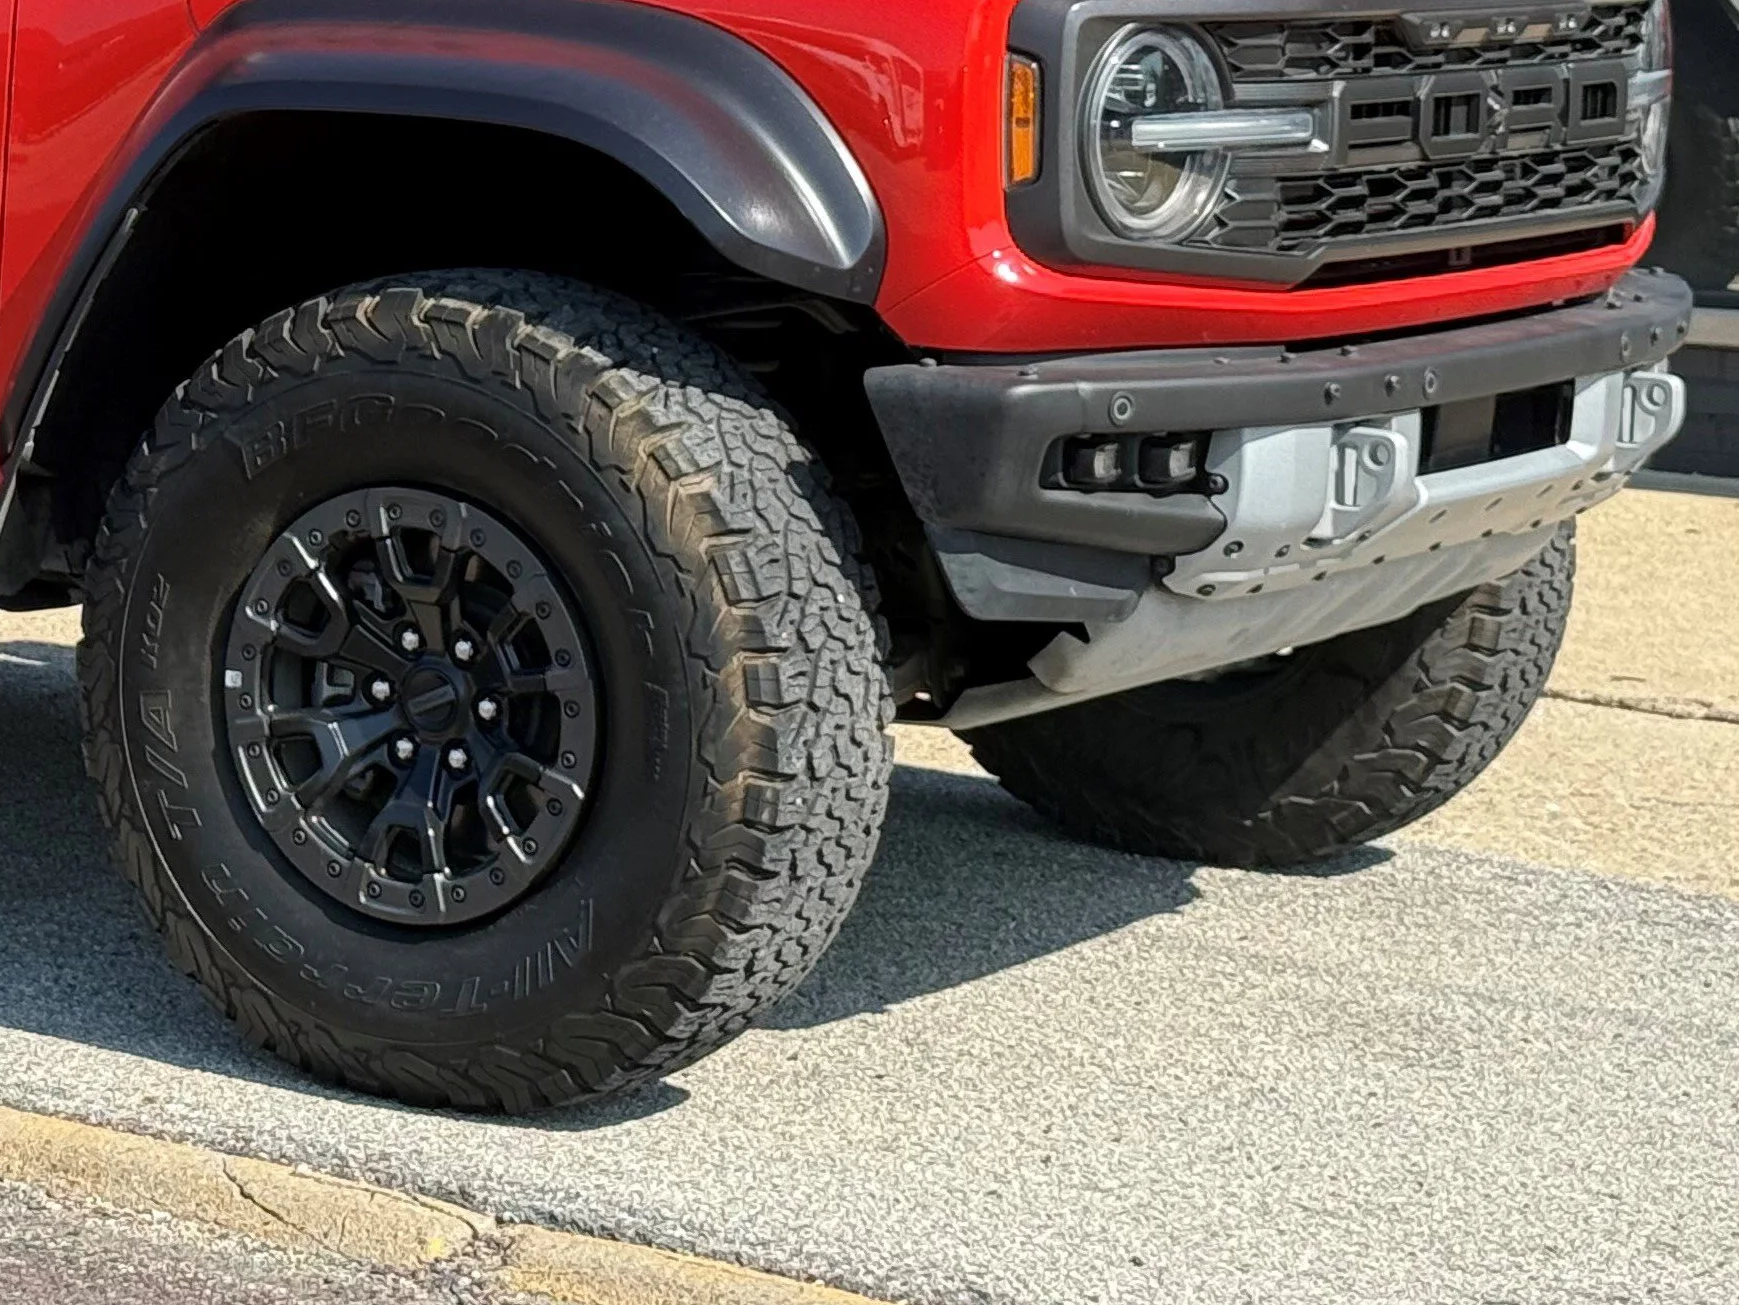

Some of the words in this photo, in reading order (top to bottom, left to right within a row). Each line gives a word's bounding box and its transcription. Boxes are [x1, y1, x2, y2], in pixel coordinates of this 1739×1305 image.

[1332, 60, 1628, 166] FORD
[226, 392, 656, 656] BFGoodrich
[140, 688, 202, 842] T/A
